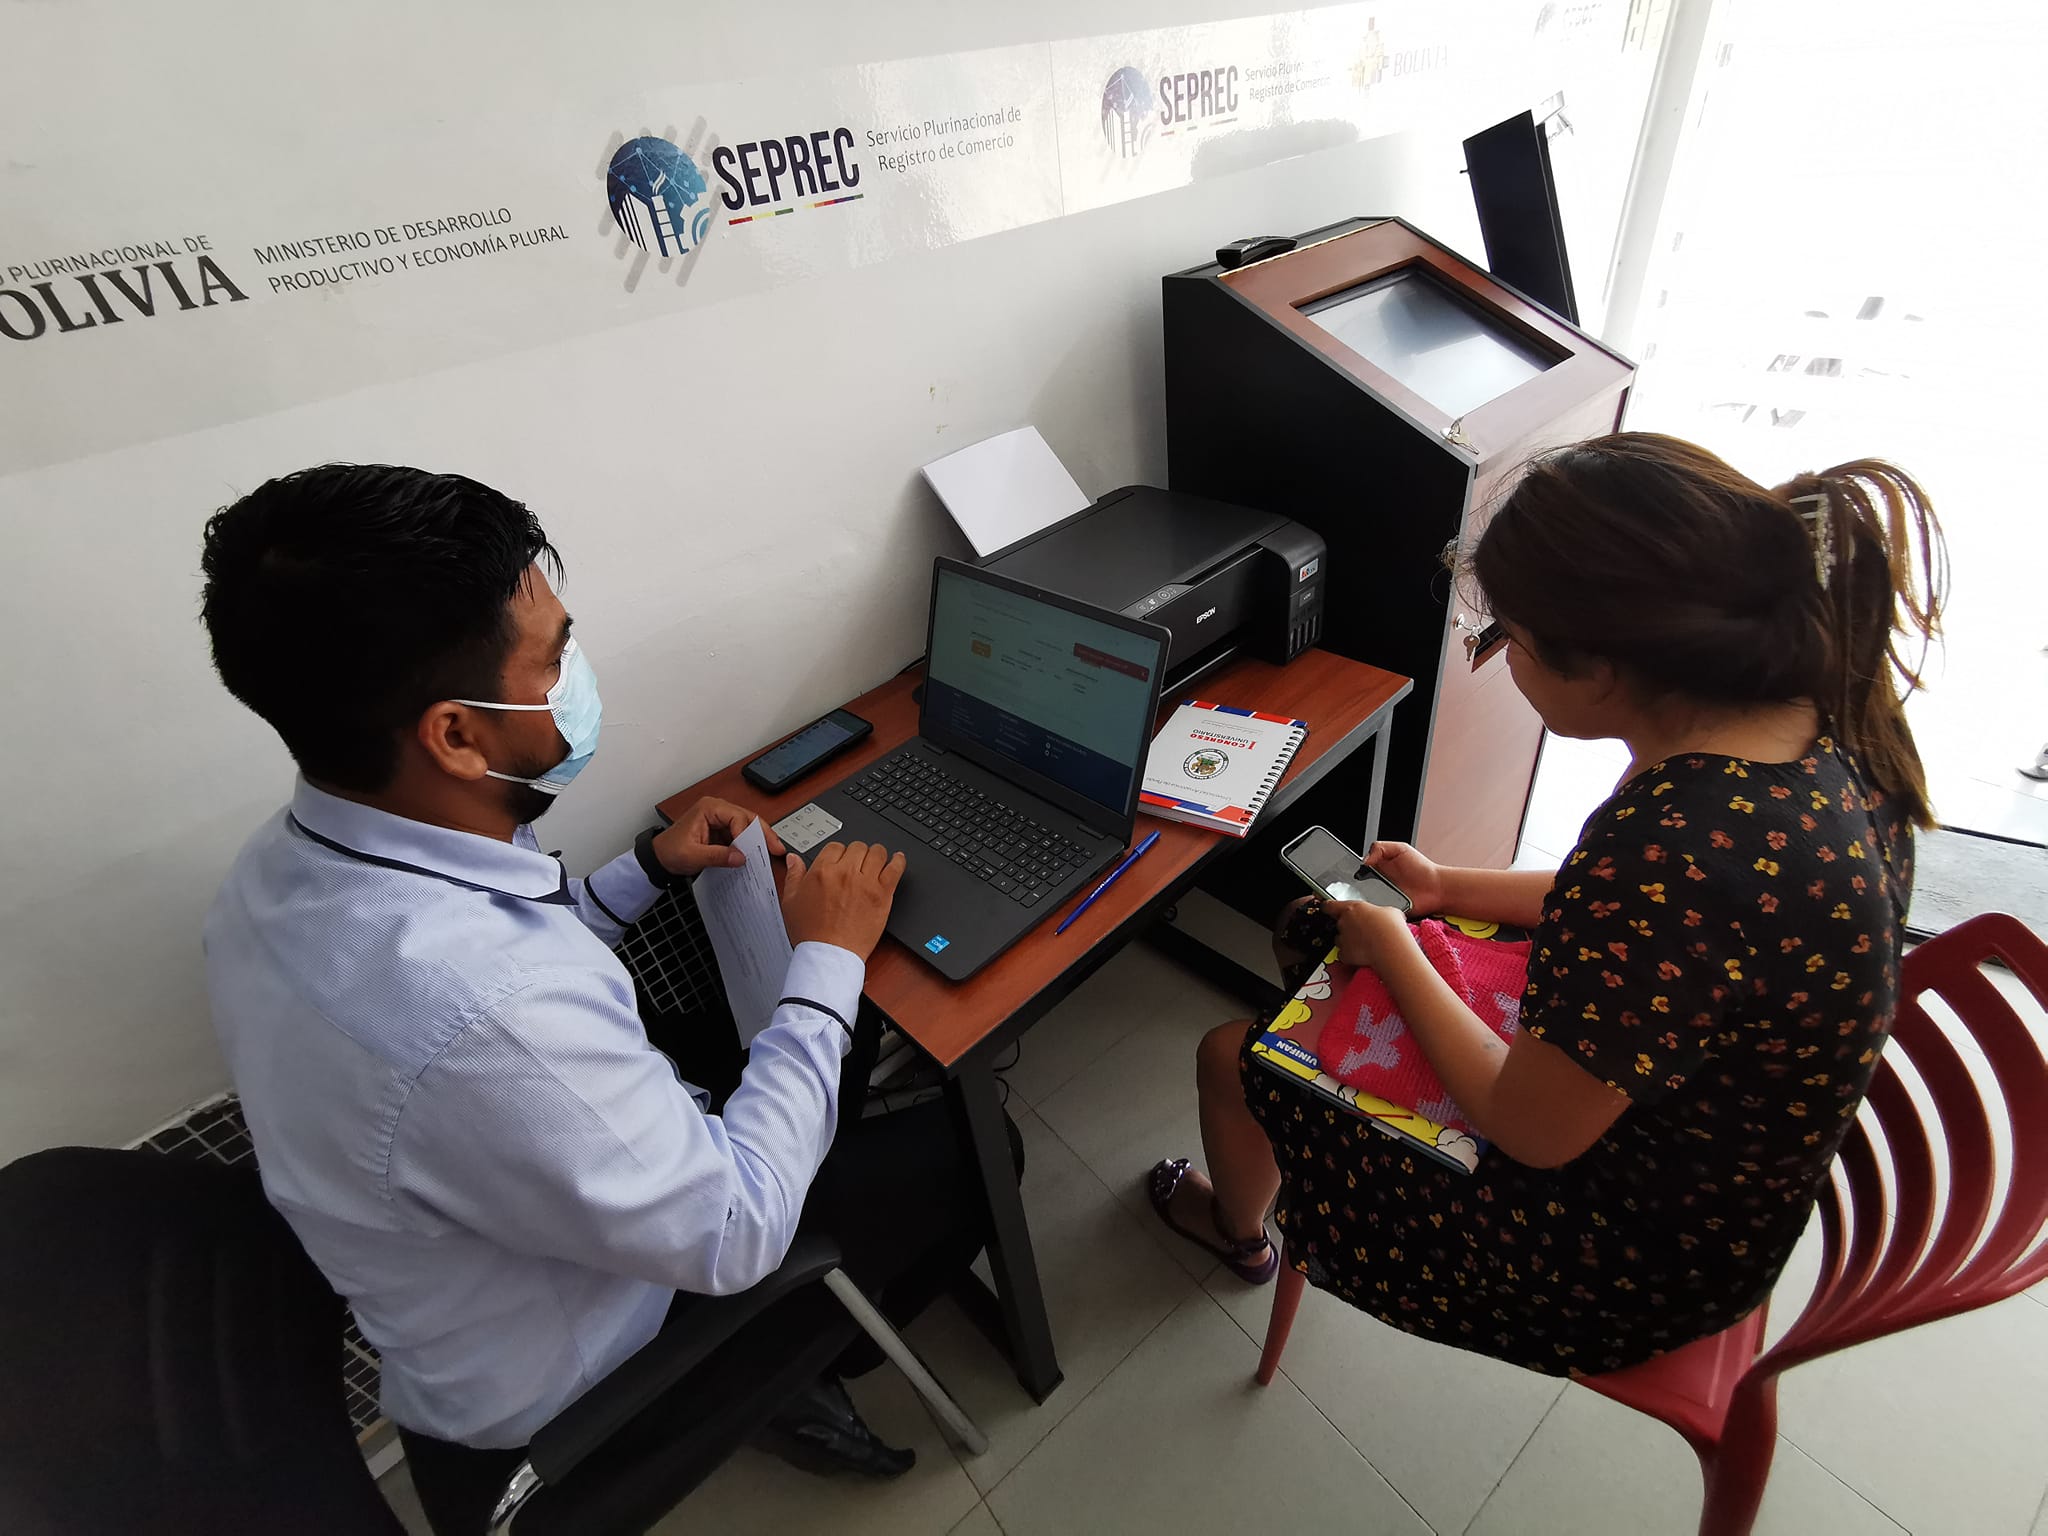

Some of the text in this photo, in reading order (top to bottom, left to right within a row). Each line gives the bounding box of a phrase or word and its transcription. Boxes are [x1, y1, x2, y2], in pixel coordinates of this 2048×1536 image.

[1244, 64, 1277, 82] Servicio
[1249, 83, 1283, 103] Registro
[1284, 81, 1295, 94] de
[1160, 65, 1239, 126] SEPREC
[866, 105, 1022, 148] Servicio Plurinacional de
[712, 127, 860, 211] SEPREC
[877, 132, 1015, 174] Registro de Comercio
[253, 207, 512, 266] MINISTERIO DE DESARROLLO
[8, 240, 181, 283] PLURINACIONAL
[182, 234, 214, 253] DE
[268, 224, 569, 295] PRODUCTIVO Y ECONOMÍA PLURAL
[0, 255, 250, 341] OLIVIA
[1196, 606, 1216, 625] EPSON
[1189, 733, 1246, 749] CONGRESO
[1192, 728, 1249, 745] UNIVERSITARIO
[1276, 1041, 1317, 1066] VINIFAN
